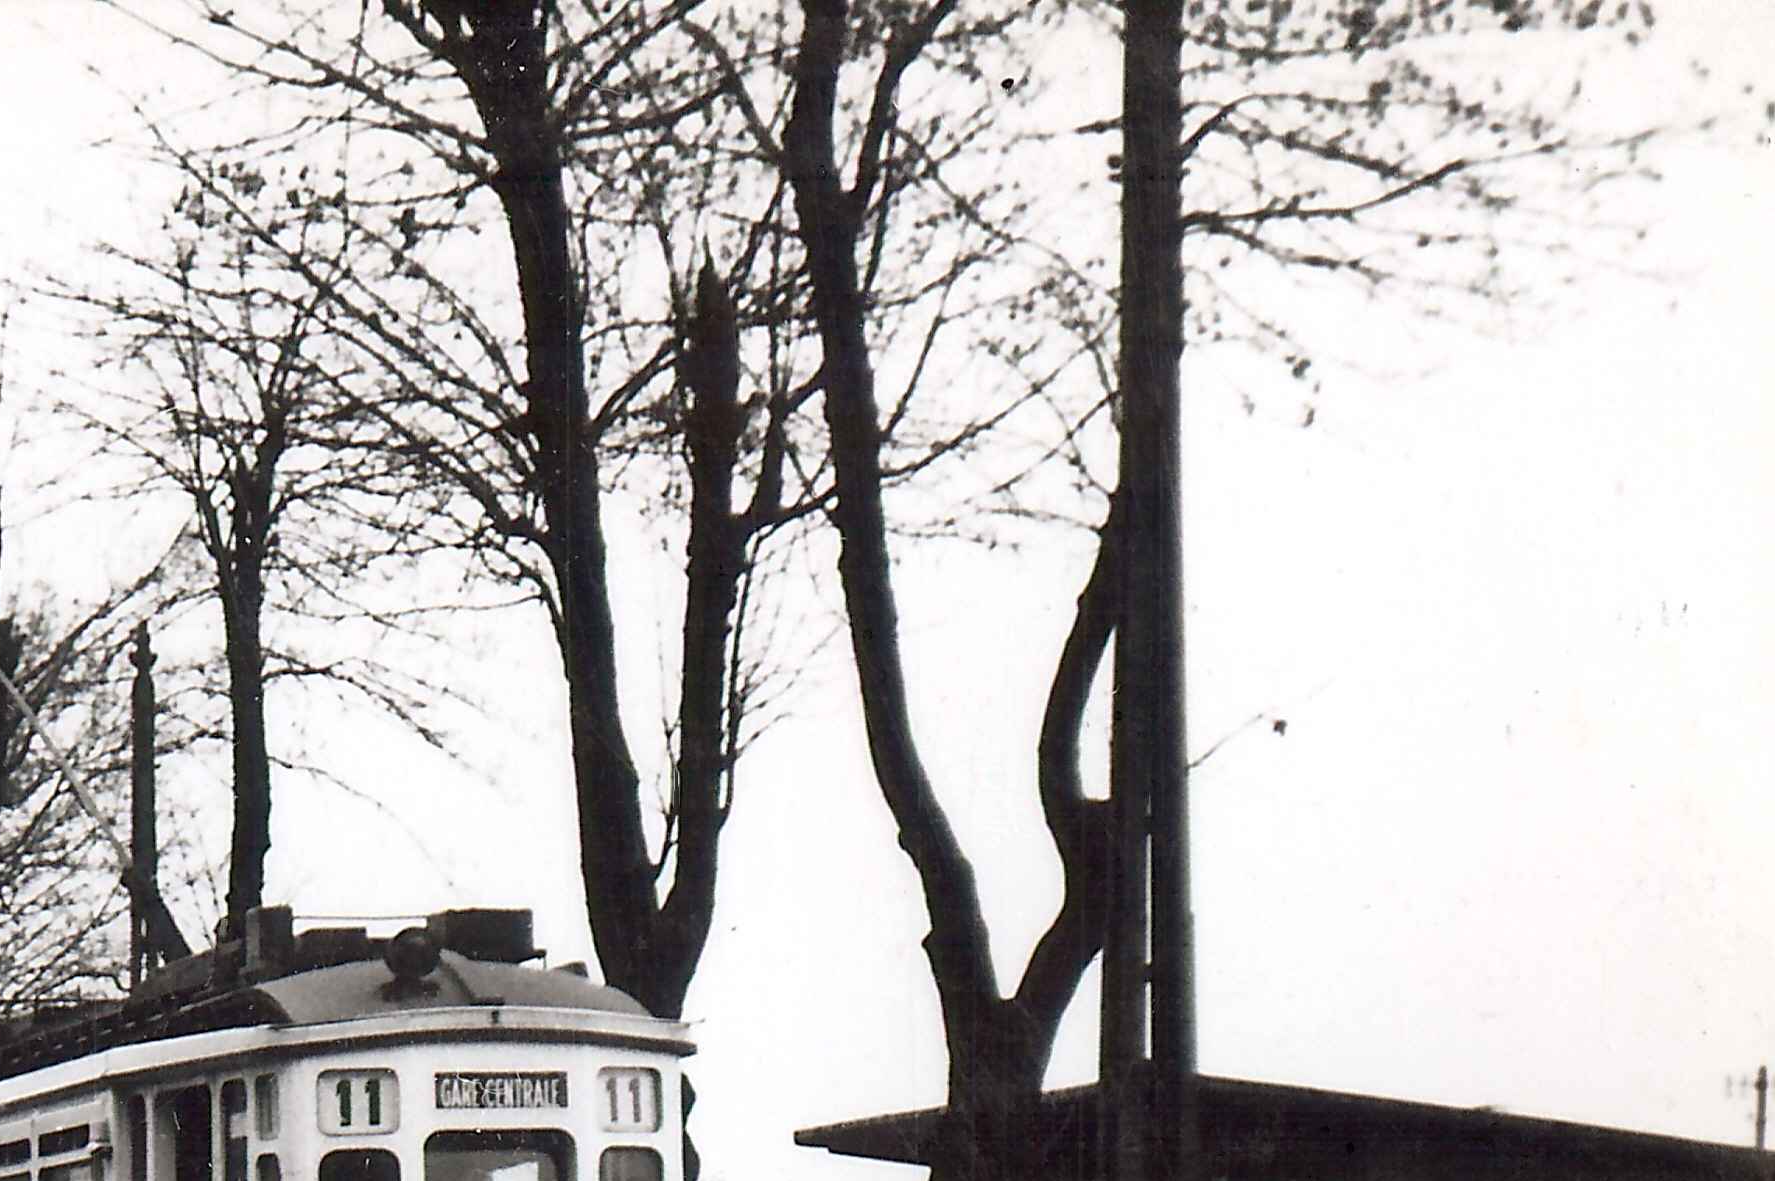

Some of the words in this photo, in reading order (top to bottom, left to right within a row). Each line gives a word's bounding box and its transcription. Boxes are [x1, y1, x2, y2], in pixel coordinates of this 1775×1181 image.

[335, 1079, 381, 1127] 11
[439, 1078, 480, 1108] GARE
[484, 1078, 563, 1108] CENTRALE
[608, 1078, 642, 1122] 11
